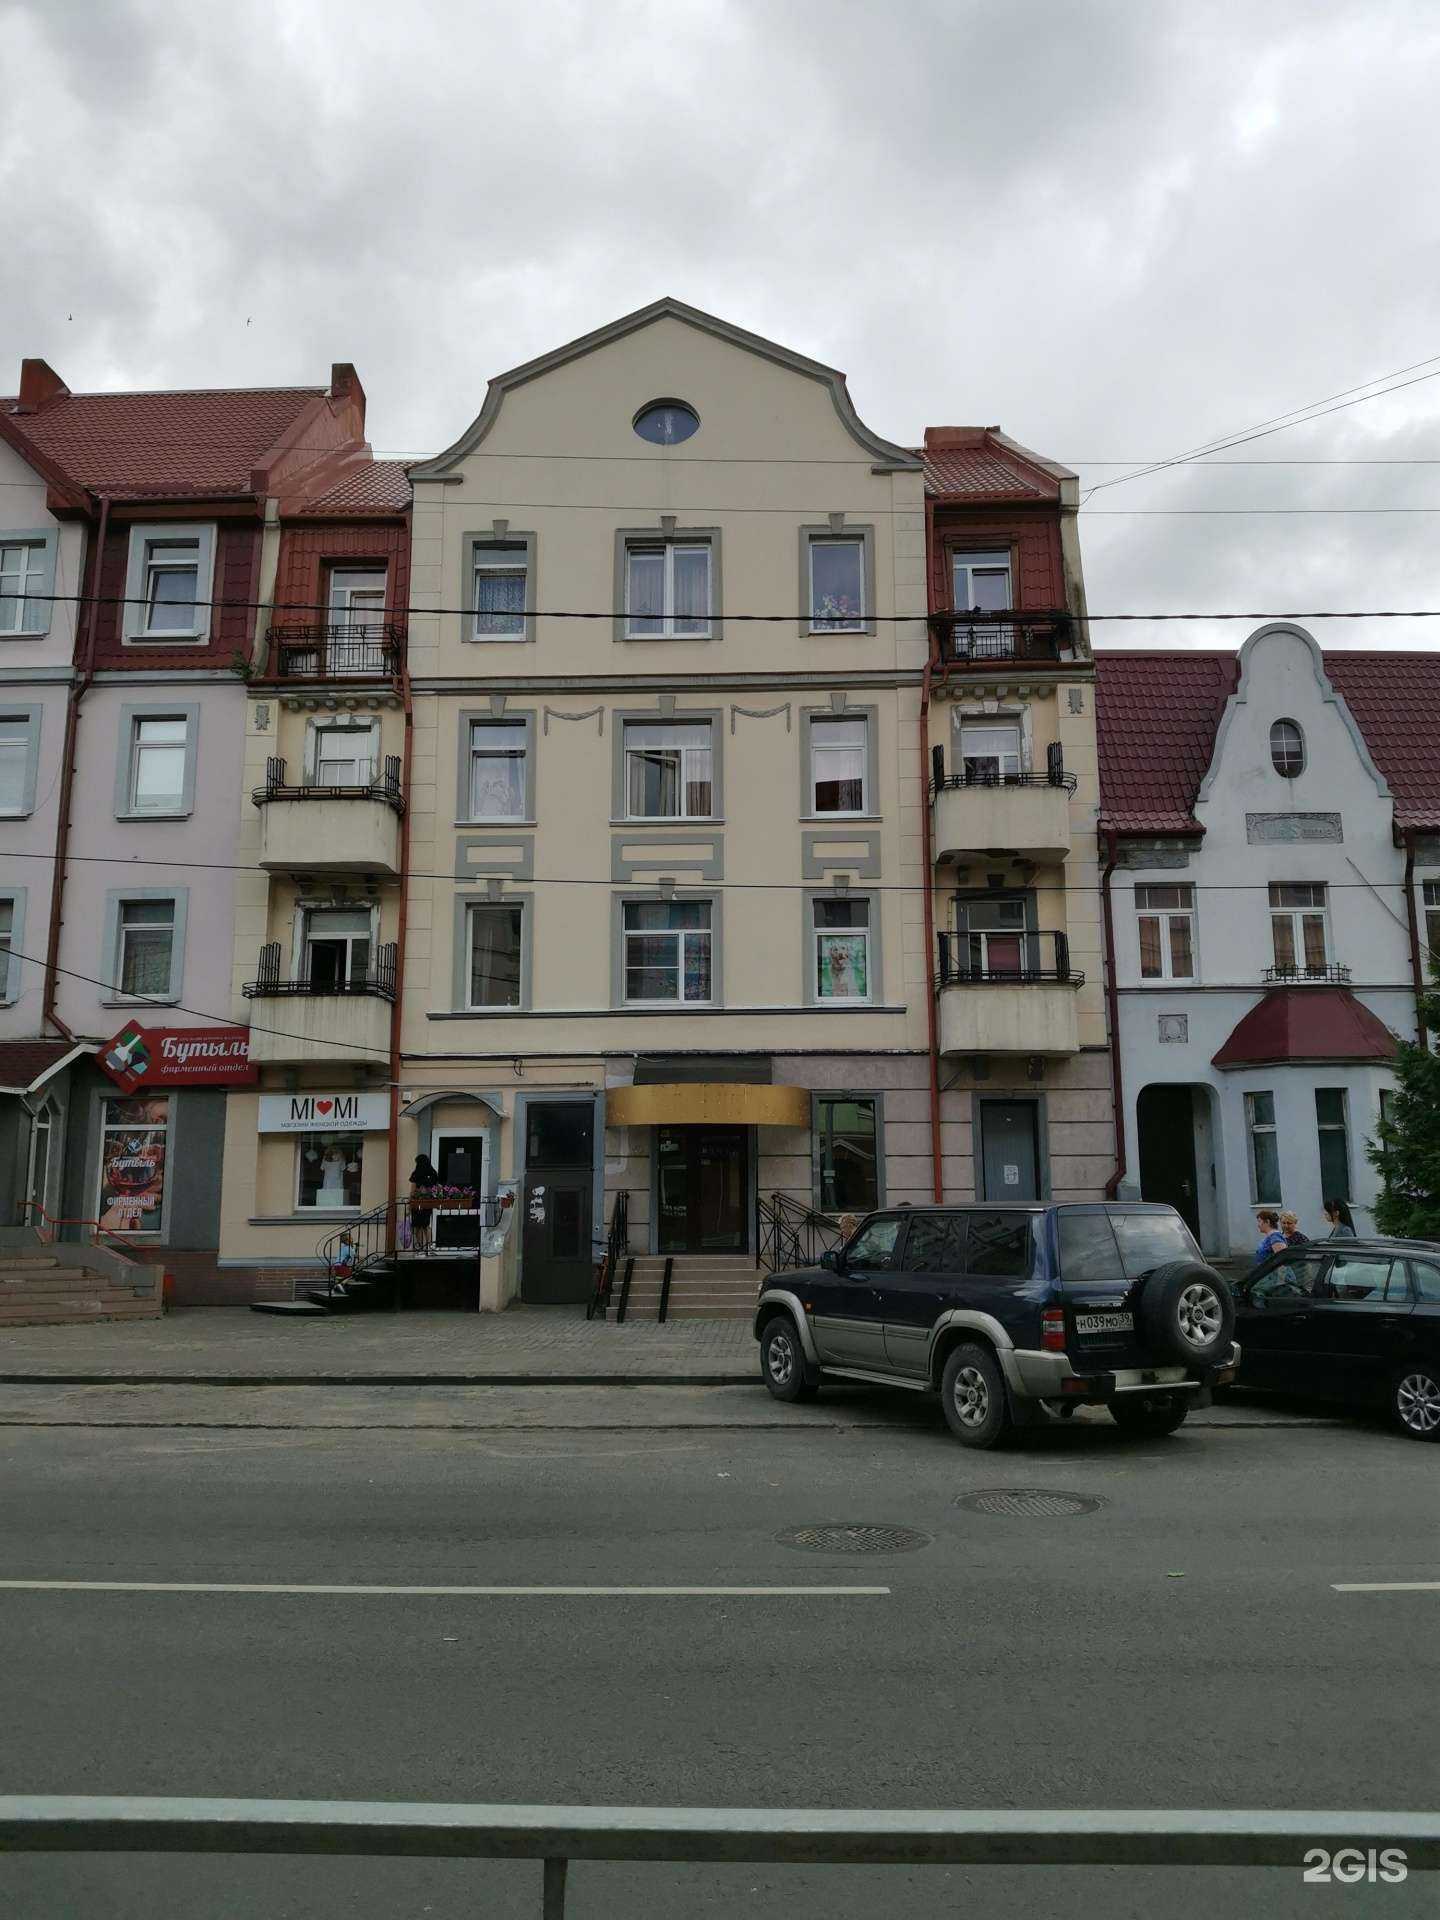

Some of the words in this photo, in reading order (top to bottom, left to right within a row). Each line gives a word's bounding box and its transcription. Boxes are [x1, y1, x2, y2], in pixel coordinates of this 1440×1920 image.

[161, 1037, 249, 1063] Бутыль
[160, 1064, 216, 1073] фирменный
[219, 1063, 249, 1072] отдел
[111, 1156, 156, 1169] Бутыль
